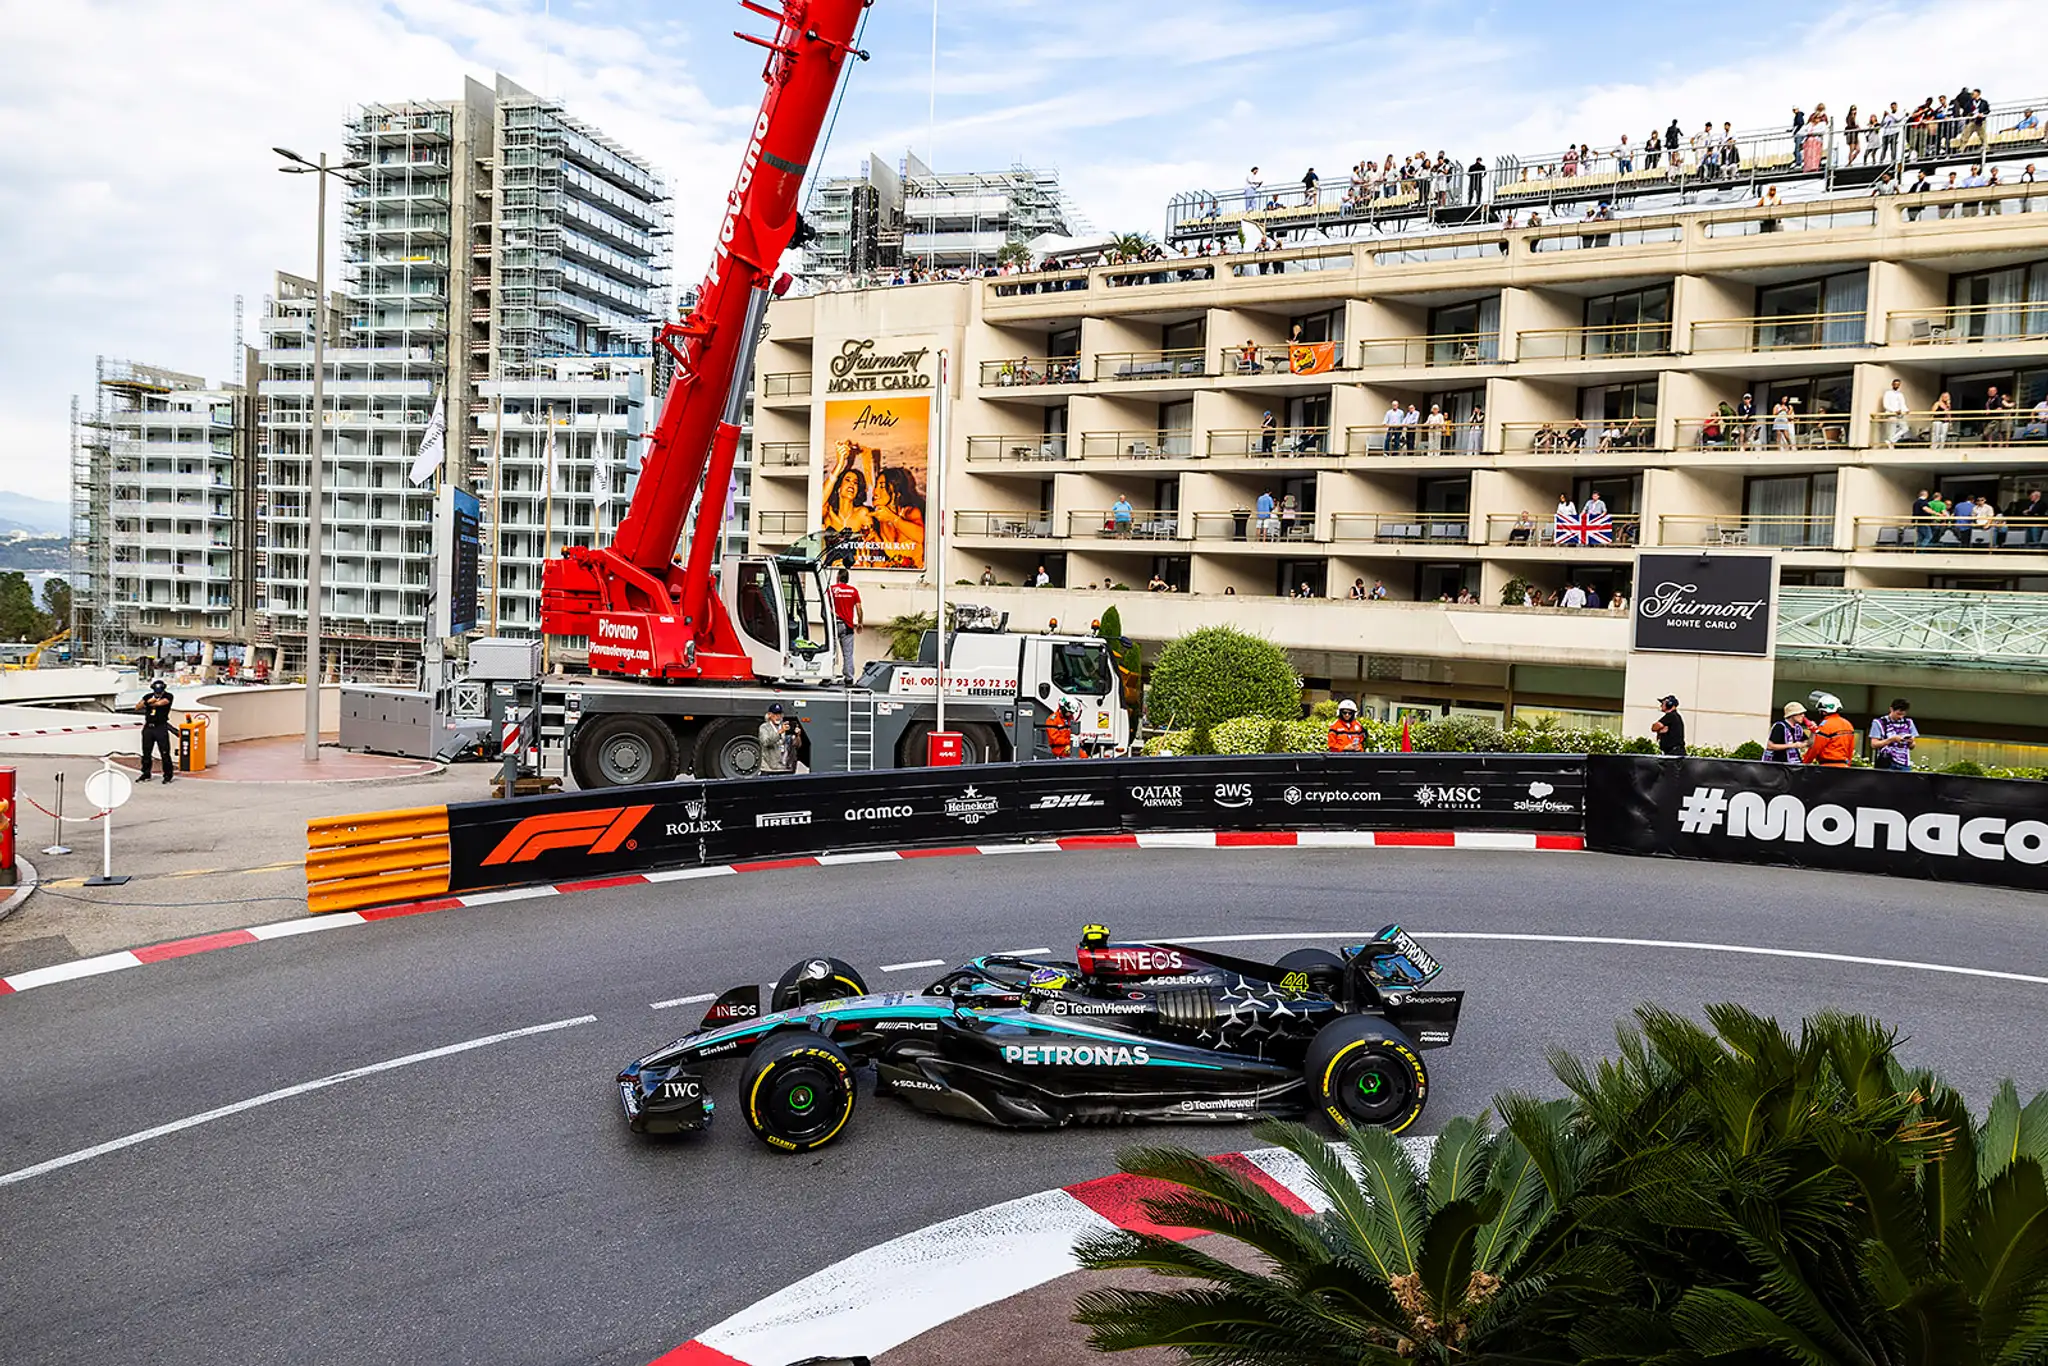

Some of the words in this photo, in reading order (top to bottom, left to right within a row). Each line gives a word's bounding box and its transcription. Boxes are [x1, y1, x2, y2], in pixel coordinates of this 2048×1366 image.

[830, 339, 930, 378] Fairmont
[828, 378, 877, 392] MONTE
[881, 374, 931, 389] CARLO
[865, 541, 917, 550] RESTAURANT
[1640, 582, 1767, 620] Fairmont
[598, 619, 639, 640] Piovano
[1667, 619, 1701, 629] MONTE
[1704, 620, 1737, 630] CARLO
[956, 679, 969, 687] 93
[973, 679, 986, 688] 50
[989, 679, 1000, 688] 72
[1005, 680, 1017, 689] 50
[968, 688, 1016, 697] LIEBHERR
[1131, 786, 1182, 800] QATAR
[1214, 783, 1252, 798] aws
[1305, 789, 1381, 802] crypto.com
[1437, 787, 1481, 802] MSC
[948, 801, 995, 812] Heineken
[1039, 794, 1096, 809] DHL
[1143, 799, 1183, 807] AIRWAYS
[756, 811, 812, 827] PIRELLI
[844, 805, 913, 820] aramco
[665, 820, 722, 836] ROLEX
[1393, 931, 1437, 975] PETRONAS
[1116, 952, 1183, 971] INEOS
[1157, 976, 1204, 985] SOLERA
[1280, 971, 1310, 992] 44
[1029, 987, 1051, 996] AMD
[1405, 995, 1457, 1004] Snapdragon
[716, 1005, 757, 1016] INEOS
[1068, 1002, 1147, 1014] TeamViewer
[897, 1022, 938, 1030] AMG
[792, 1048, 804, 1057] P
[806, 1048, 847, 1072] ZERO
[1006, 1045, 1150, 1066] PETRONAS
[1395, 1045, 1425, 1084] ZERO
[664, 1082, 700, 1098] IWC
[900, 1081, 936, 1090] SOLERA
[1192, 1099, 1255, 1109] TeamViewer
